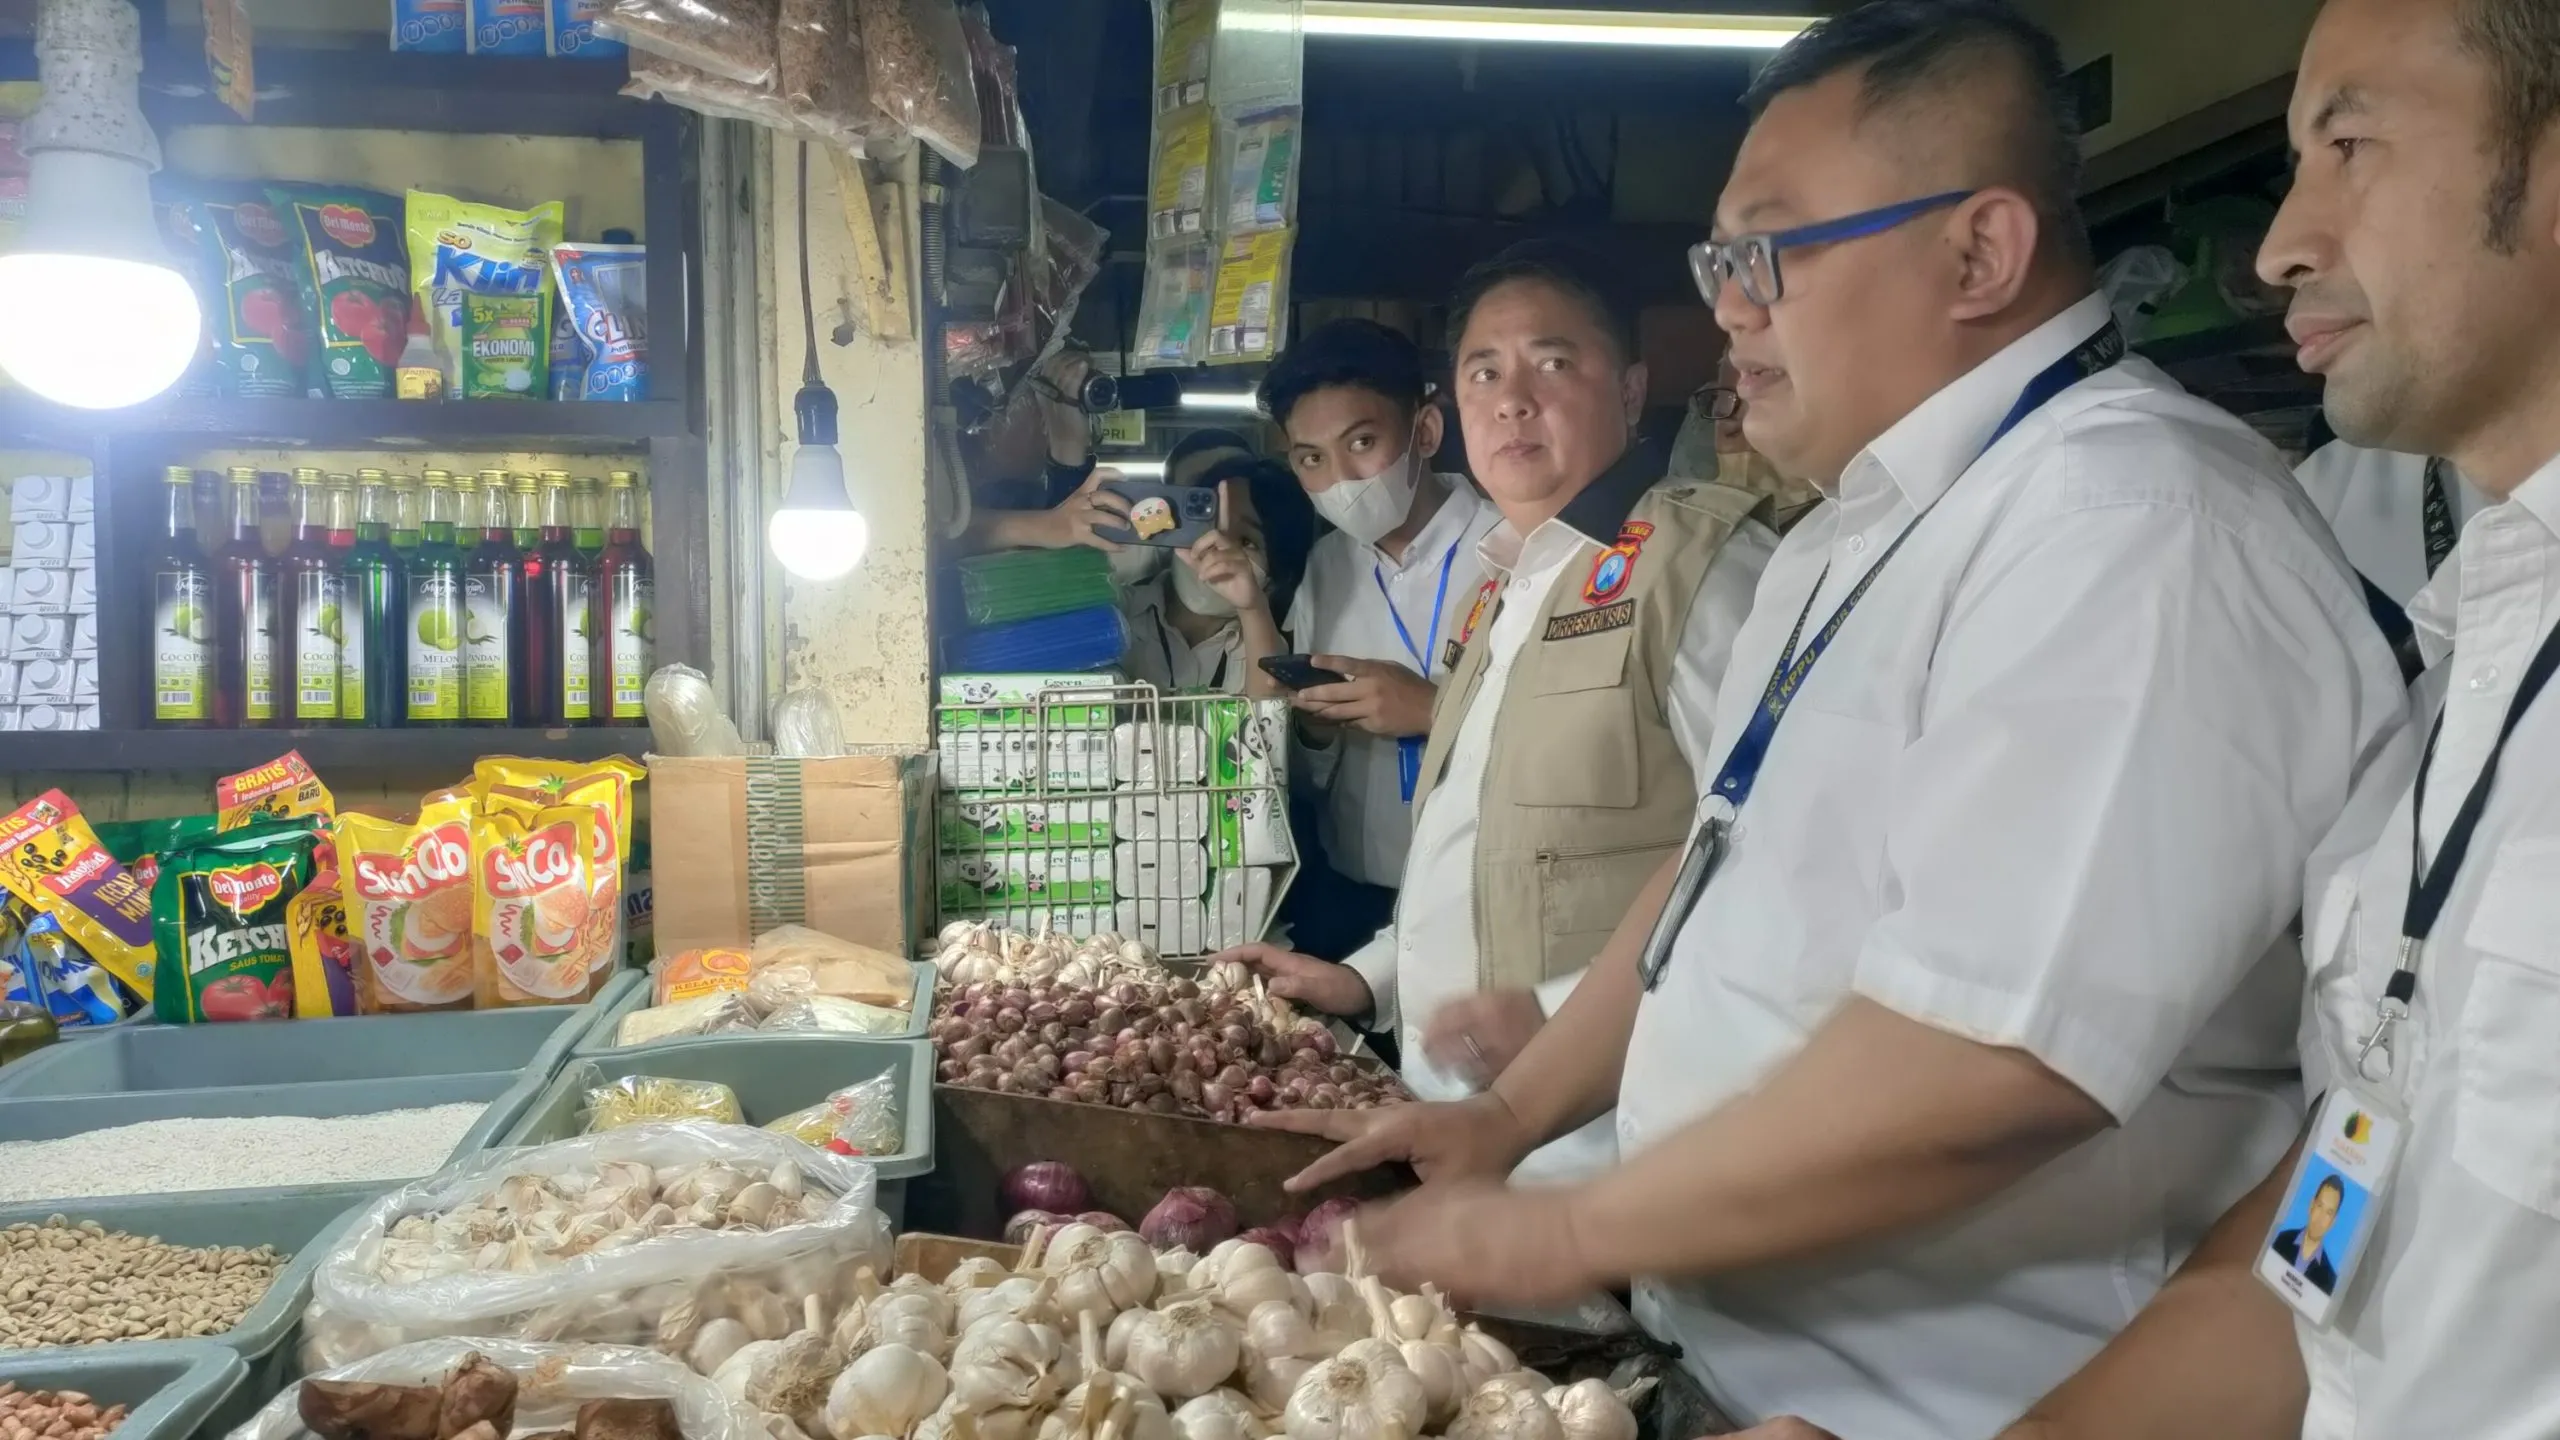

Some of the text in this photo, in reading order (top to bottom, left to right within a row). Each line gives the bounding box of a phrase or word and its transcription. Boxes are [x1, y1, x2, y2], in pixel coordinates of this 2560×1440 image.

[323, 214, 371, 234] Del Monte
[472, 338, 535, 357] EKONOMI
[1780, 648, 1817, 698] KPPU
[1823, 609, 1850, 643] FAIR
[234, 760, 287, 792] GRATIS
[232, 792, 239, 804] 1
[298, 786, 320, 803] BARU
[359, 837, 468, 894] SunCo
[93, 872, 139, 904] KECAP
[230, 955, 257, 971] SAUS
[674, 977, 727, 991] KELAPA
